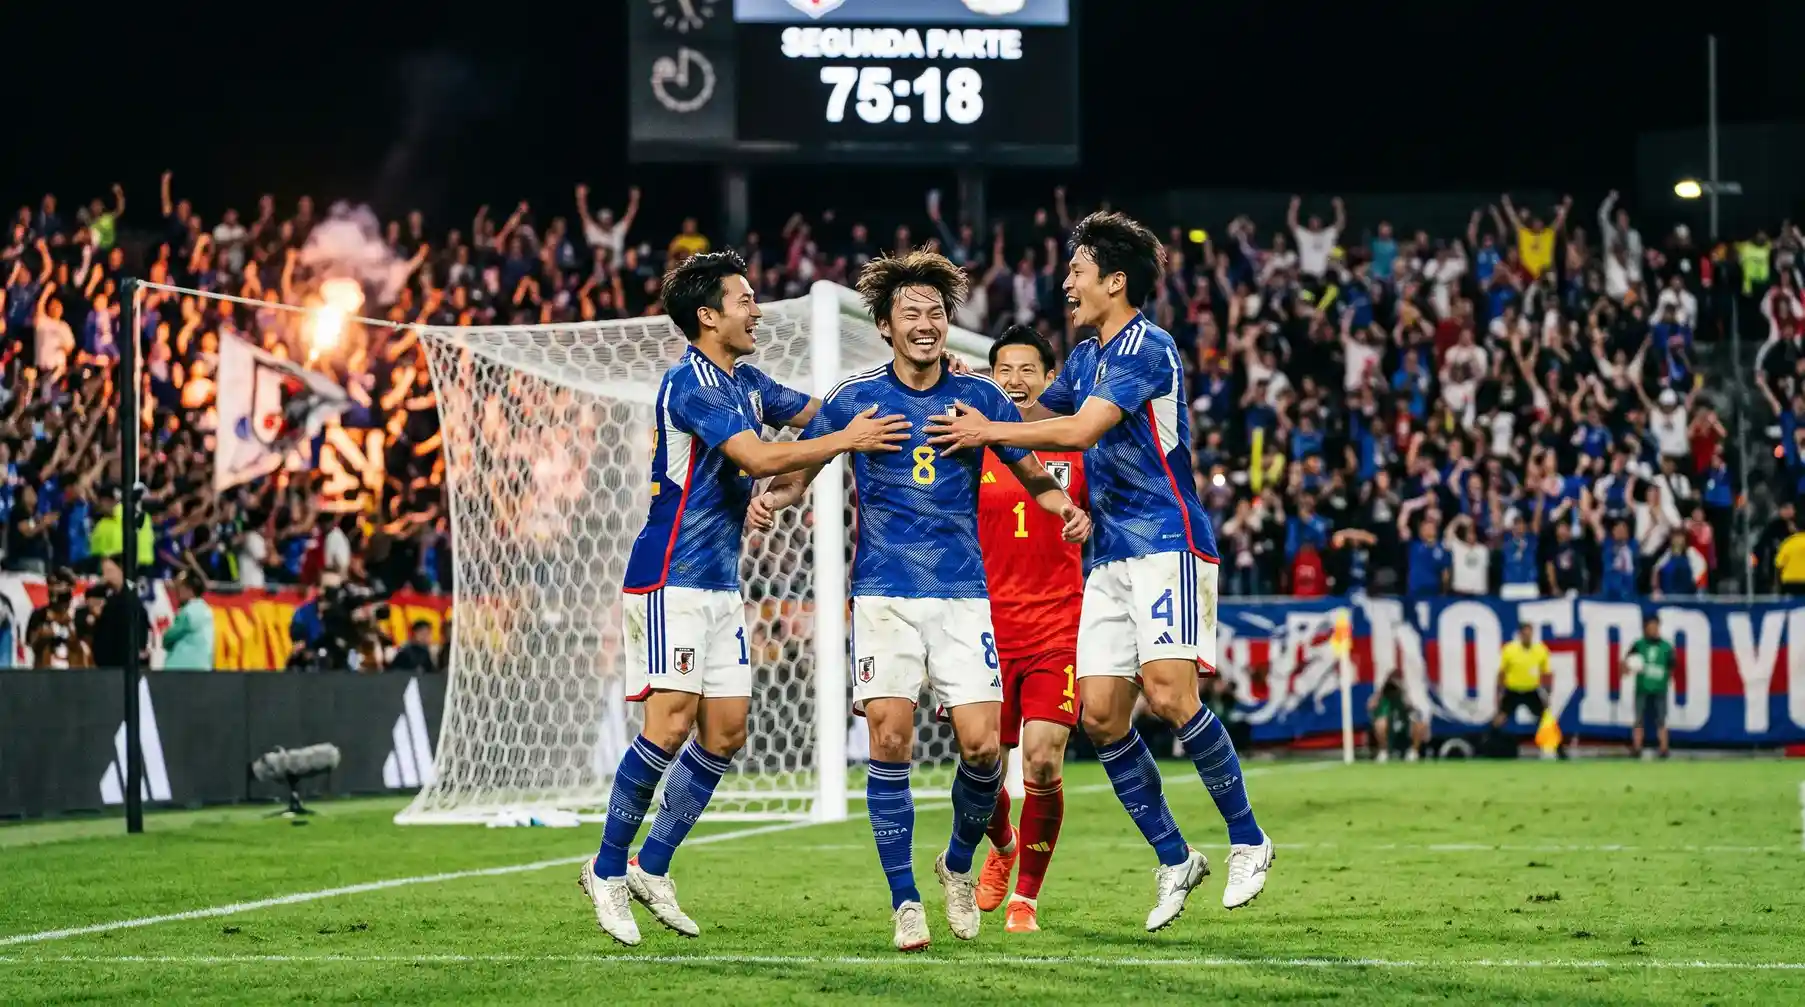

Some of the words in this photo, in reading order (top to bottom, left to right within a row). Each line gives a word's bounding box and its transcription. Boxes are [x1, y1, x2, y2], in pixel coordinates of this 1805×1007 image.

[781, 27, 925, 58] SEGUNDA
[926, 29, 1023, 59] PARTE
[820, 67, 984, 124] 75:18
[913, 446, 936, 485] 8
[1012, 502, 1029, 537] 1
[1151, 588, 1174, 626] 4
[735, 626, 749, 665] 1
[981, 632, 999, 669] 8
[1063, 664, 1076, 699] 1
